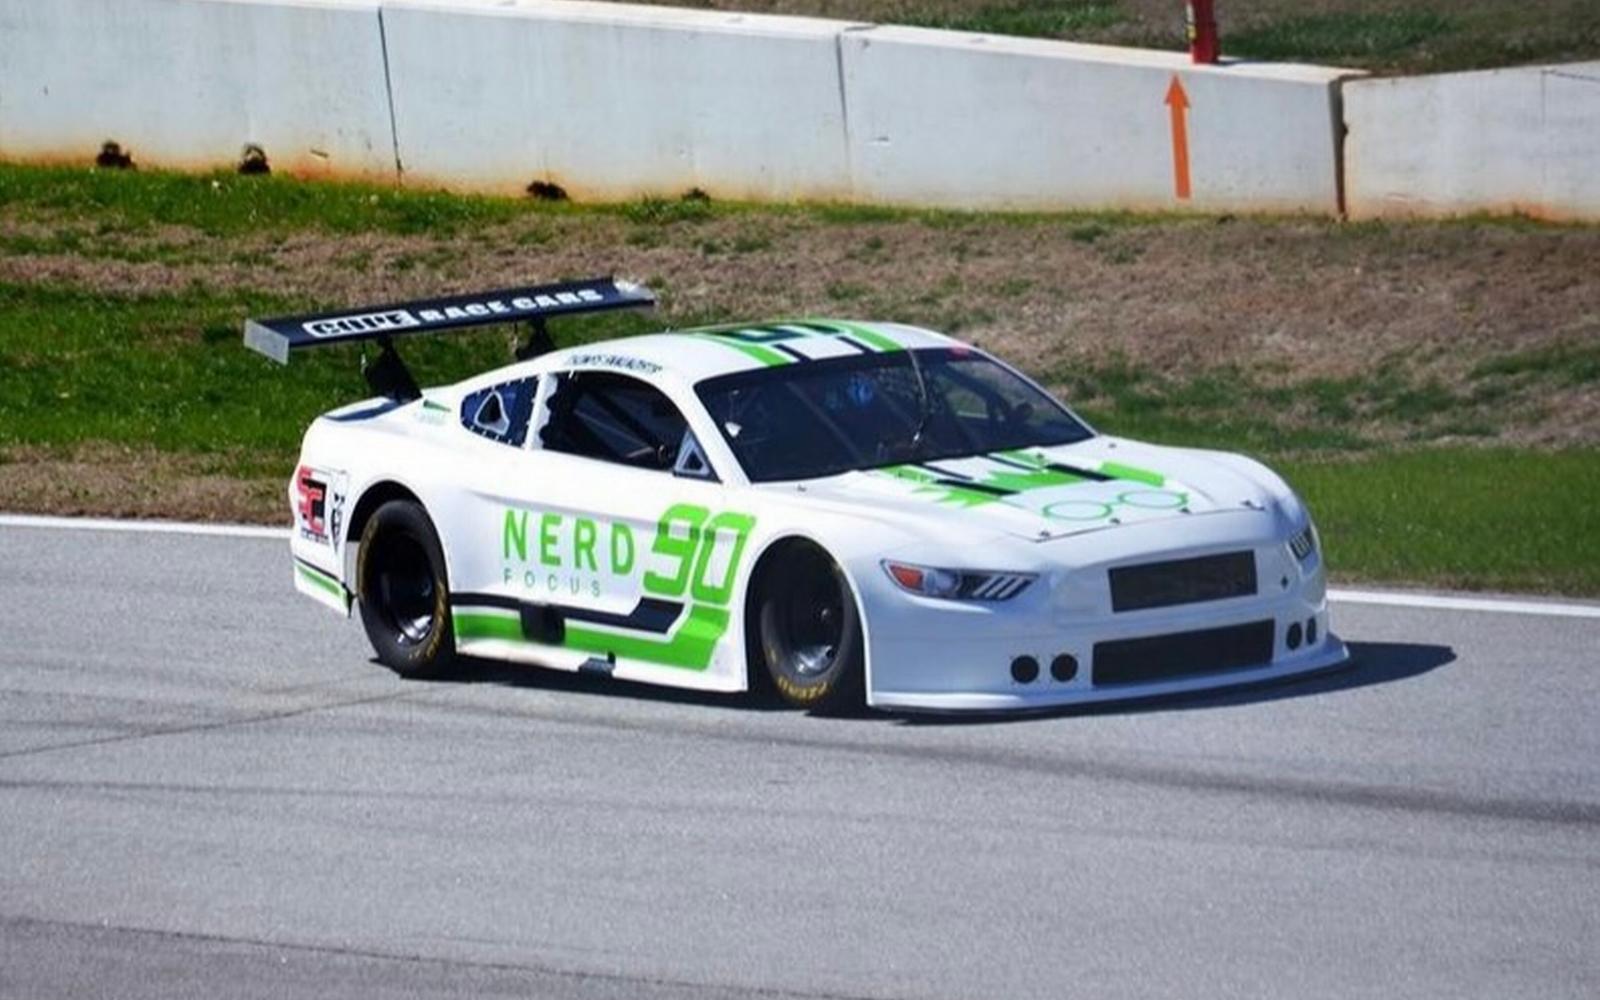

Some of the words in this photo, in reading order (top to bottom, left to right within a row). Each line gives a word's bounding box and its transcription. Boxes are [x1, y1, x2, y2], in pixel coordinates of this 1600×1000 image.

[418, 300, 511, 322] RACE
[511, 288, 603, 311] CARS
[503, 509, 636, 576] NERD
[642, 503, 757, 606] 90
[503, 567, 601, 597] FOCUS
